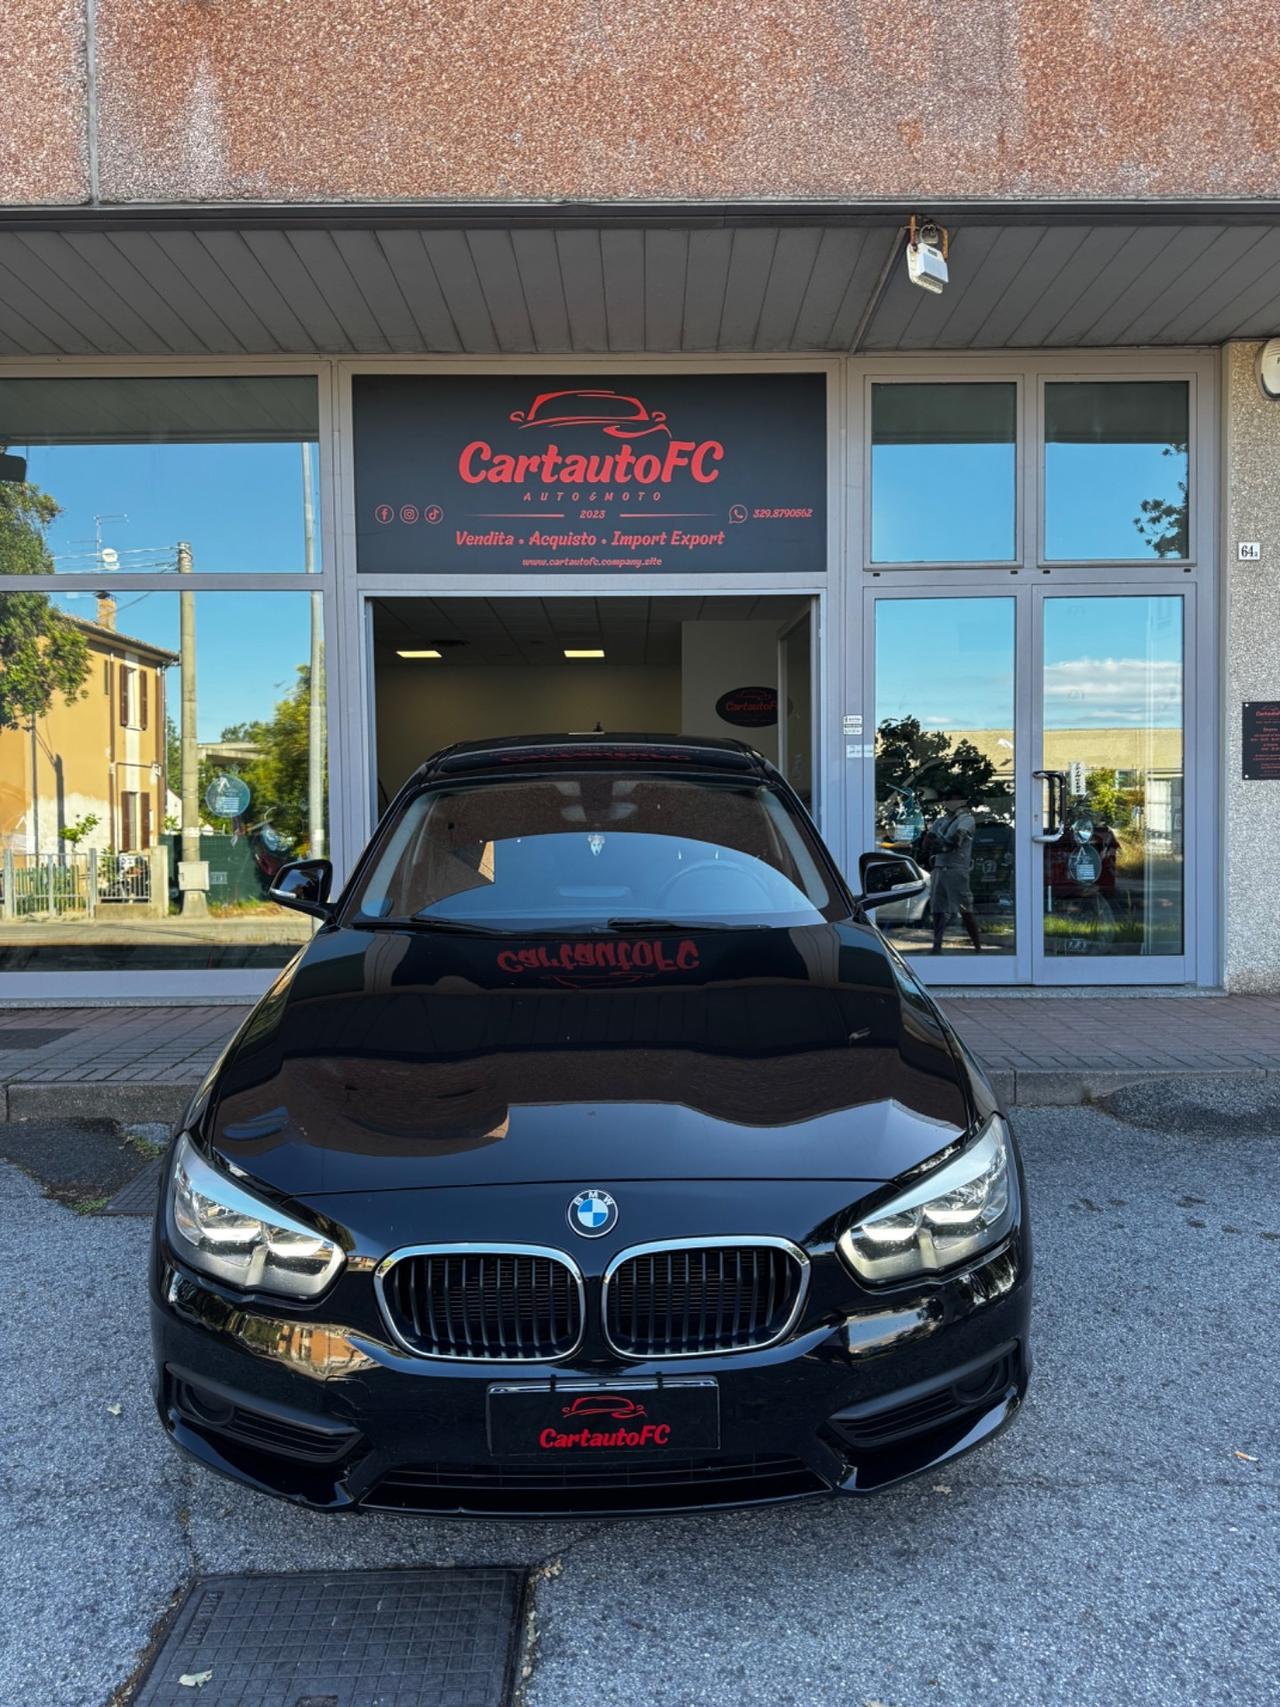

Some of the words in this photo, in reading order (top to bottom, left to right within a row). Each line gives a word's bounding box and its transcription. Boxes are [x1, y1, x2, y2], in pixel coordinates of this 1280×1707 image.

[457, 440, 725, 484] CartautoFC
[455, 530, 515, 546] Vendita
[528, 530, 597, 550] Acquisto
[611, 530, 667, 550] Import
[670, 530, 725, 550] Export
[573, 1189, 614, 1206] BMW
[538, 1423, 671, 1449] CartautoFC
